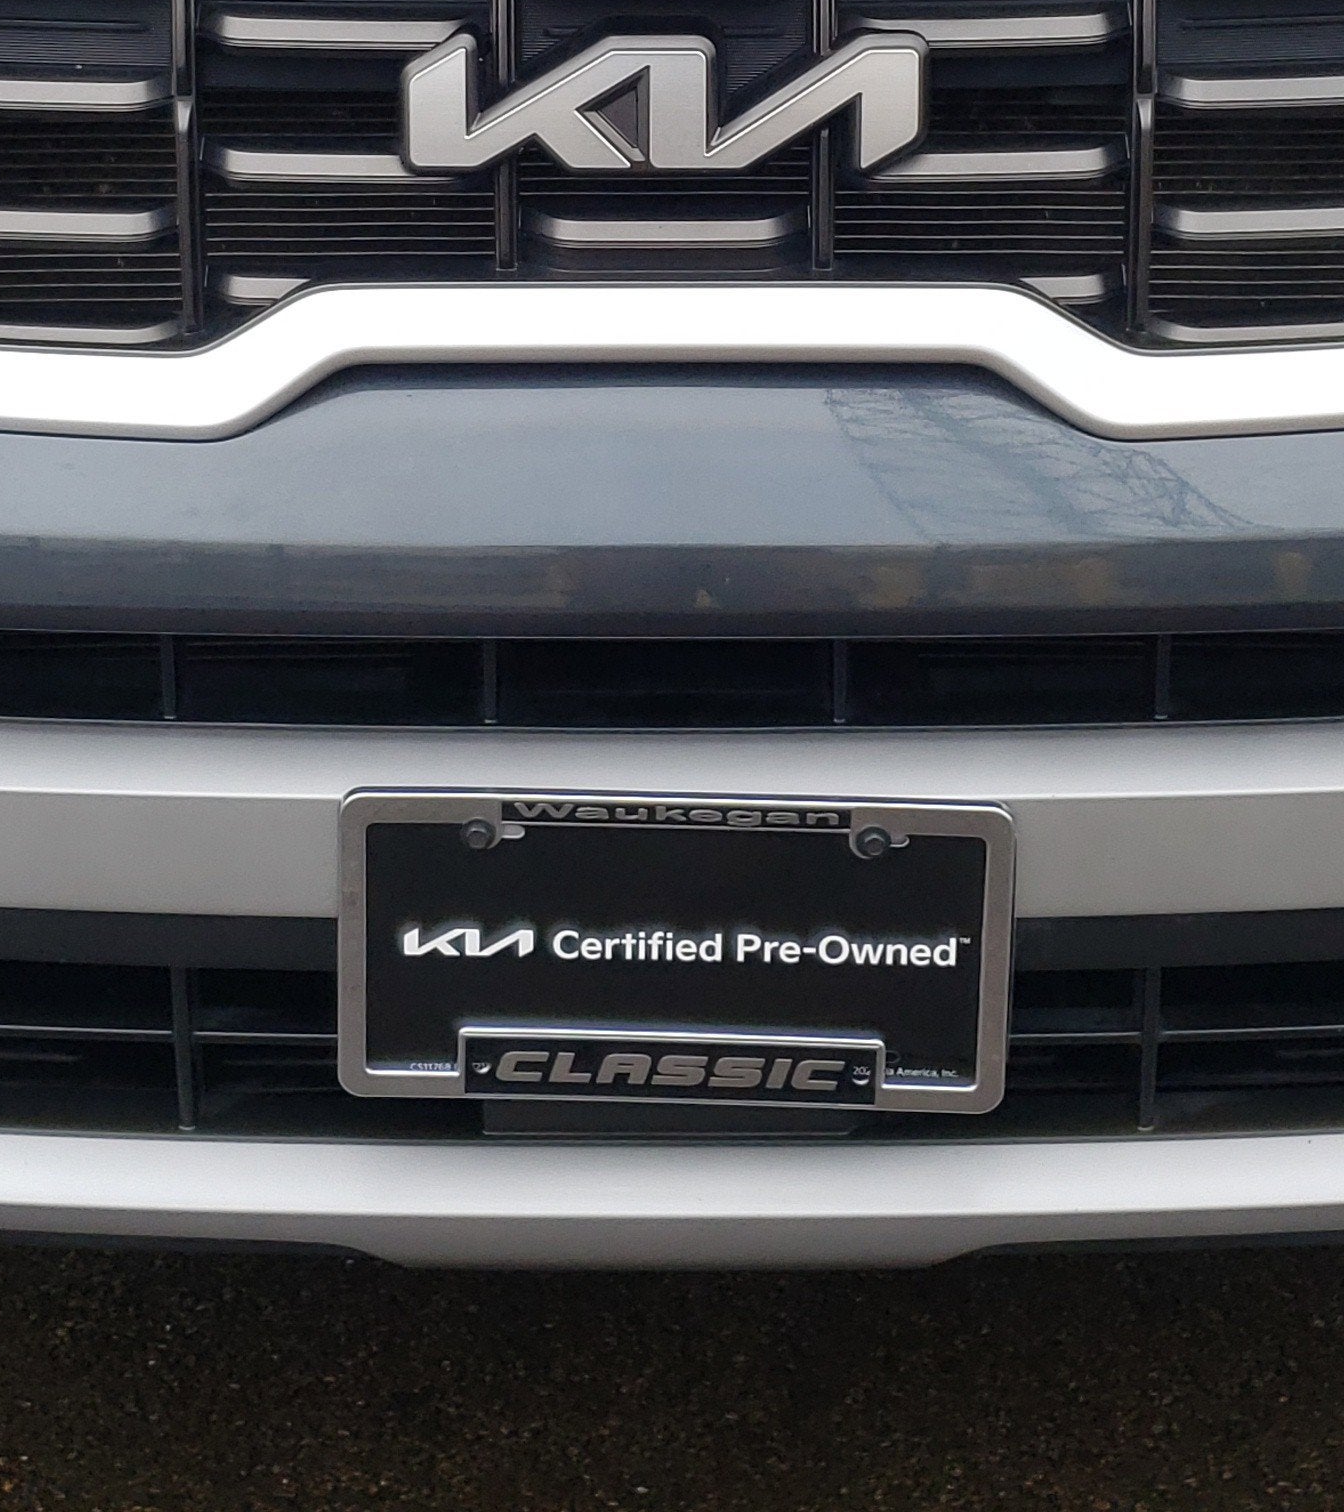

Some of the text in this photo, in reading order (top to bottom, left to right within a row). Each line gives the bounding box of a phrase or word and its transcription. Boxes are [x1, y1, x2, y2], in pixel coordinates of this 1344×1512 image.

[402, 32, 928, 172] KIA
[514, 801, 840, 827] Waukegan
[404, 928, 534, 958] KIA
[553, 930, 722, 962] Certified
[495, 1050, 845, 1091] CLASSIC
